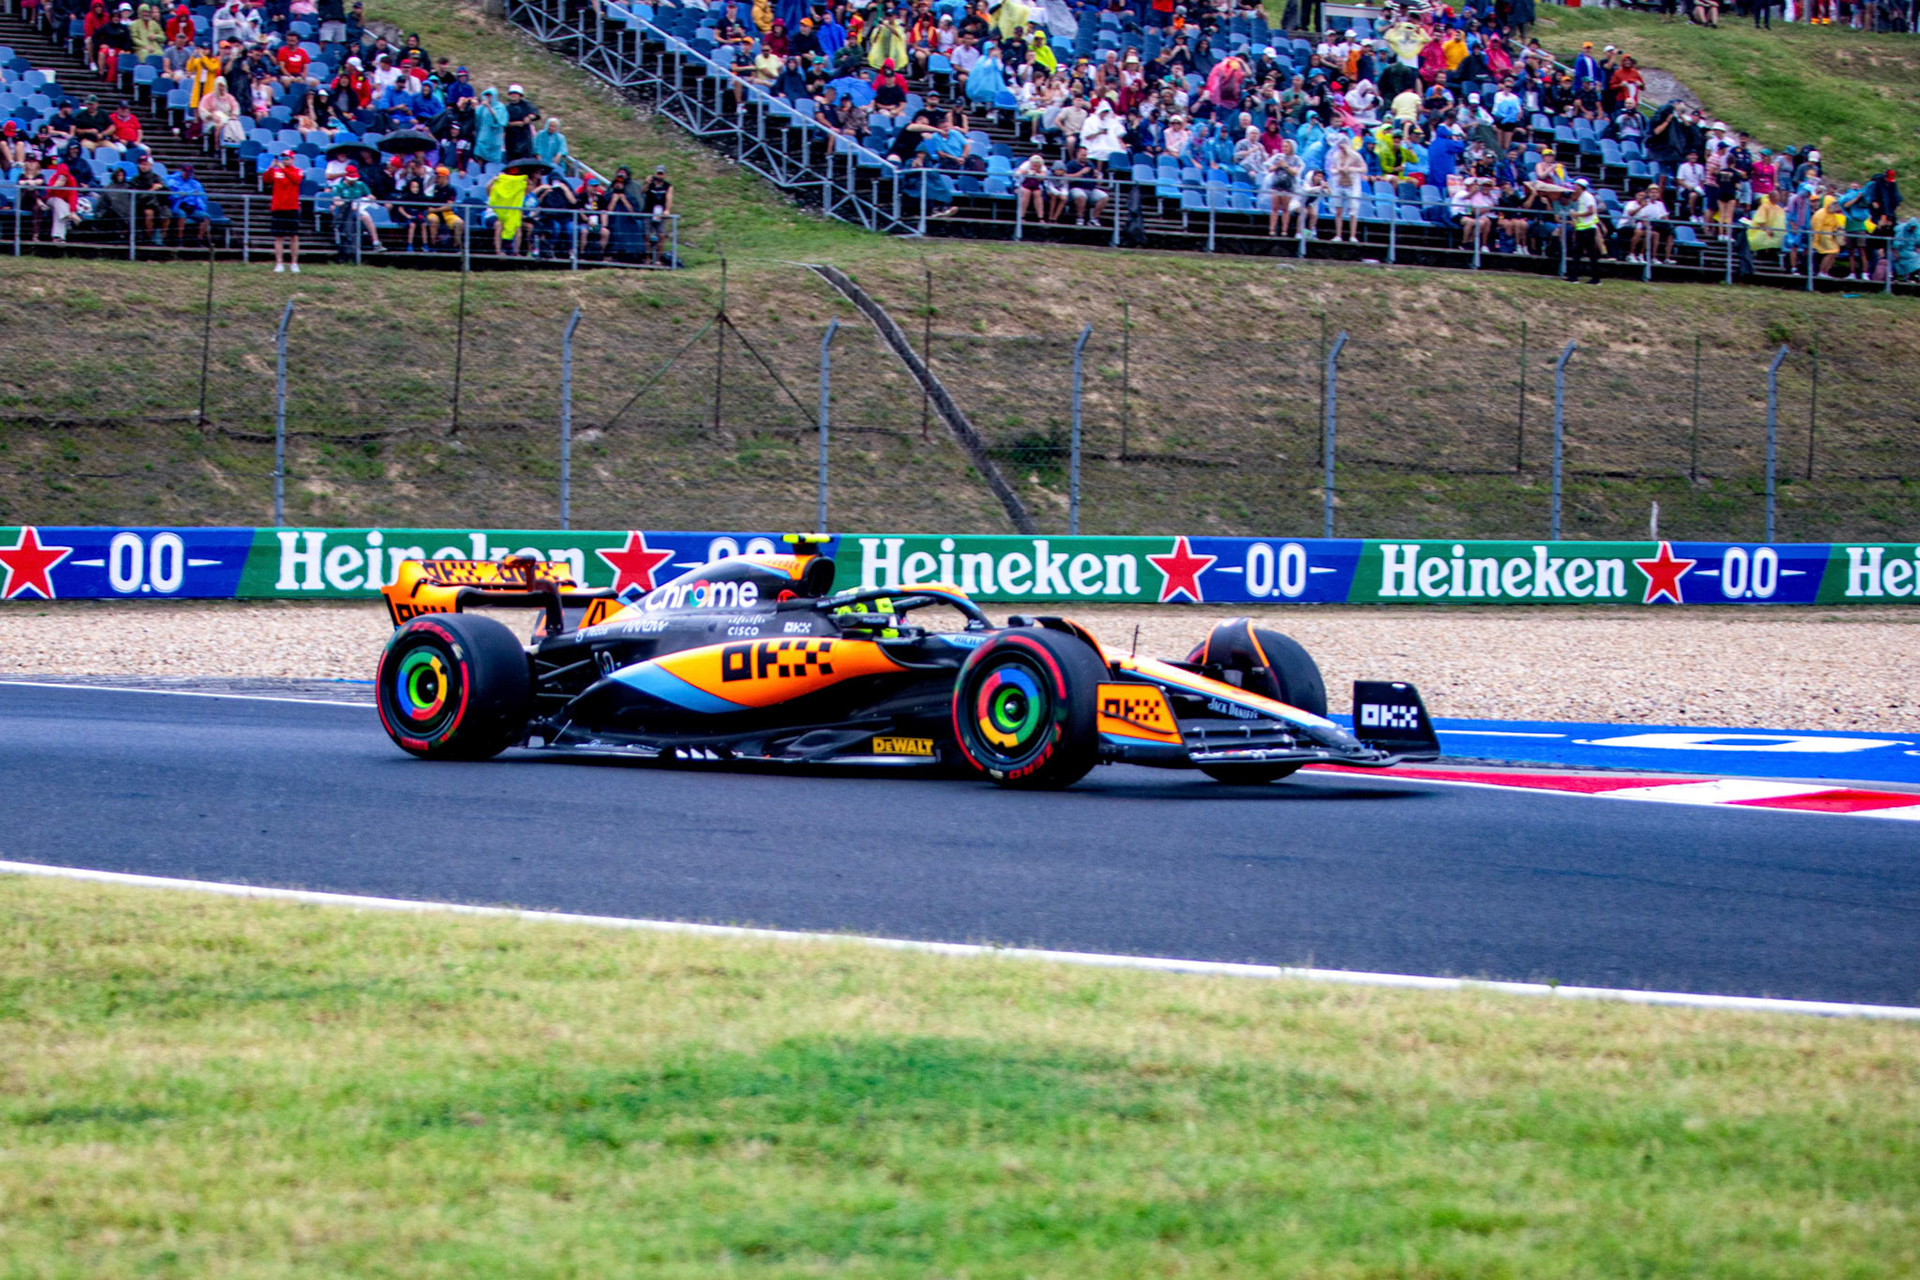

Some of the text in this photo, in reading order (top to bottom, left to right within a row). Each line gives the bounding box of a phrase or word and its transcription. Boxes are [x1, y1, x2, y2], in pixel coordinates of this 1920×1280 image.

[275, 530, 590, 591] Heikn
[859, 538, 1140, 595] Heineken
[1378, 544, 1627, 597] Heineken
[644, 579, 759, 612] Chrome
[721, 641, 834, 682] OKX
[1103, 699, 1160, 721] OKX
[1361, 703, 1418, 728] OKX
